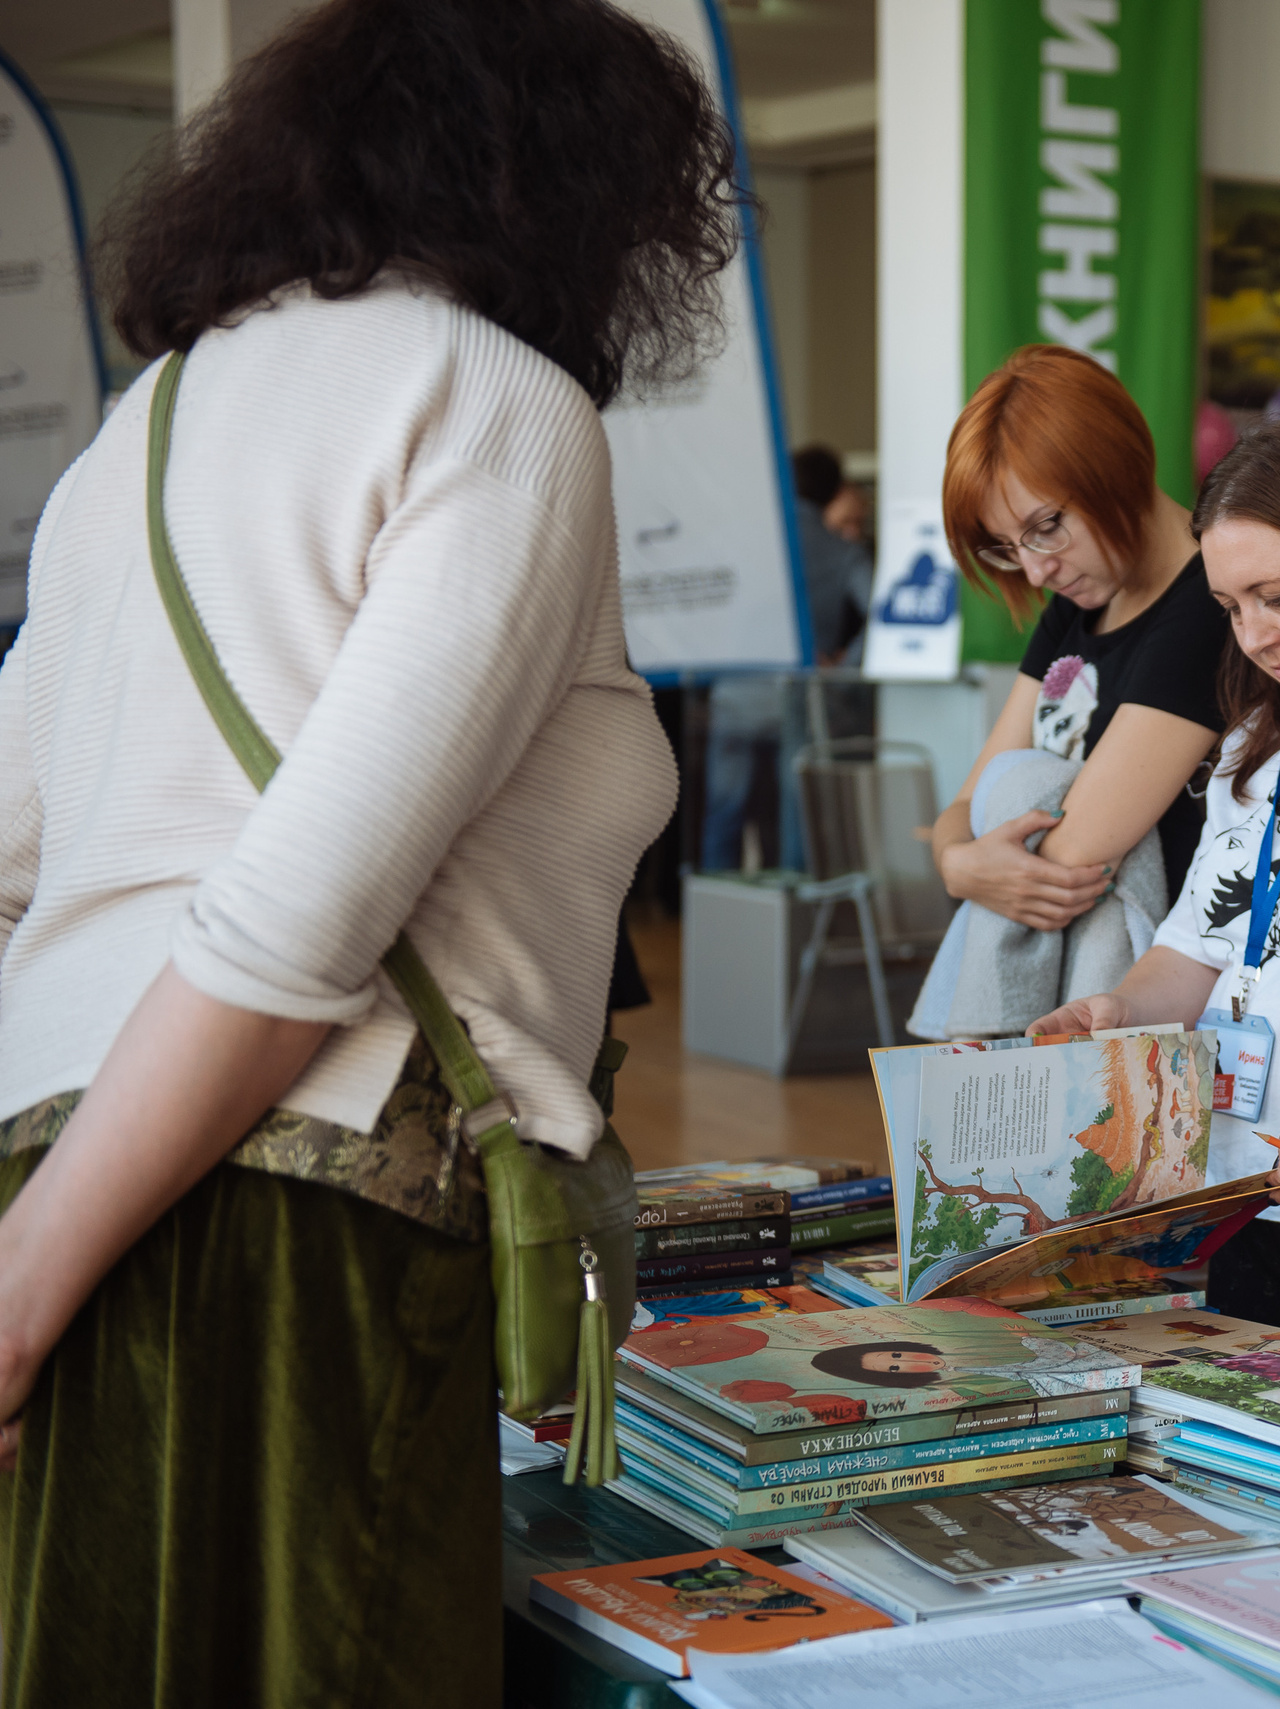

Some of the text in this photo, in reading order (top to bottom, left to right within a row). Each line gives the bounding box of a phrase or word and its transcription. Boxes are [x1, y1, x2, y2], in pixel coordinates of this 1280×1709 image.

[1038, 0, 1120, 374] КНИГИ
[1238, 1050, 1265, 1066] Ирина
[799, 1426, 901, 1454] БЕЛОСНЕЖКА
[826, 1453, 888, 1474] СНЕЖНАЯ
[834, 1475, 887, 1497] ЧАРОДЕЙ
[890, 1468, 945, 1491] ВЕЛИКИЙ
[788, 1483, 833, 1503] СТРАНЫ
